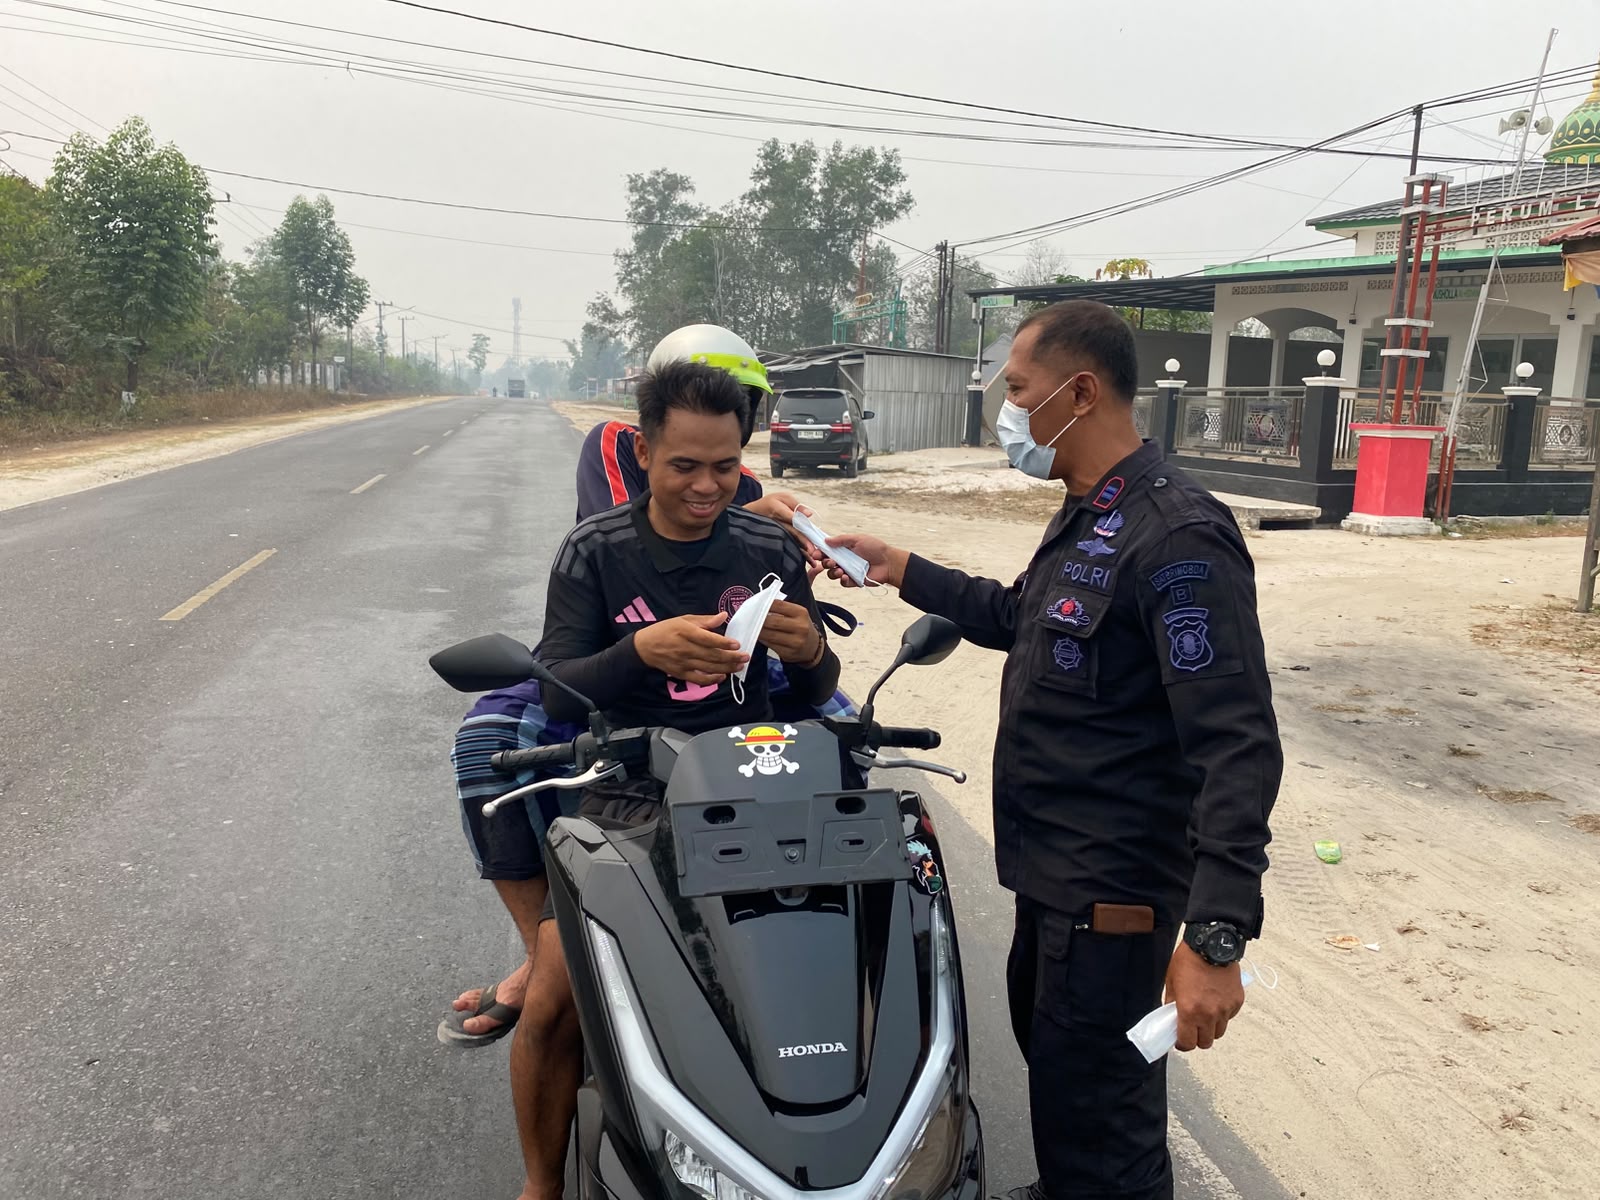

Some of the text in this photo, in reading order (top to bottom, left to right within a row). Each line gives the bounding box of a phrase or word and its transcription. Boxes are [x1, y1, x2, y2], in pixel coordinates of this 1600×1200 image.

[1471, 199, 1553, 227] PERUM
[1061, 561, 1111, 588] POLRI
[1176, 588, 1187, 601] B
[777, 1042, 848, 1058] HONDA
